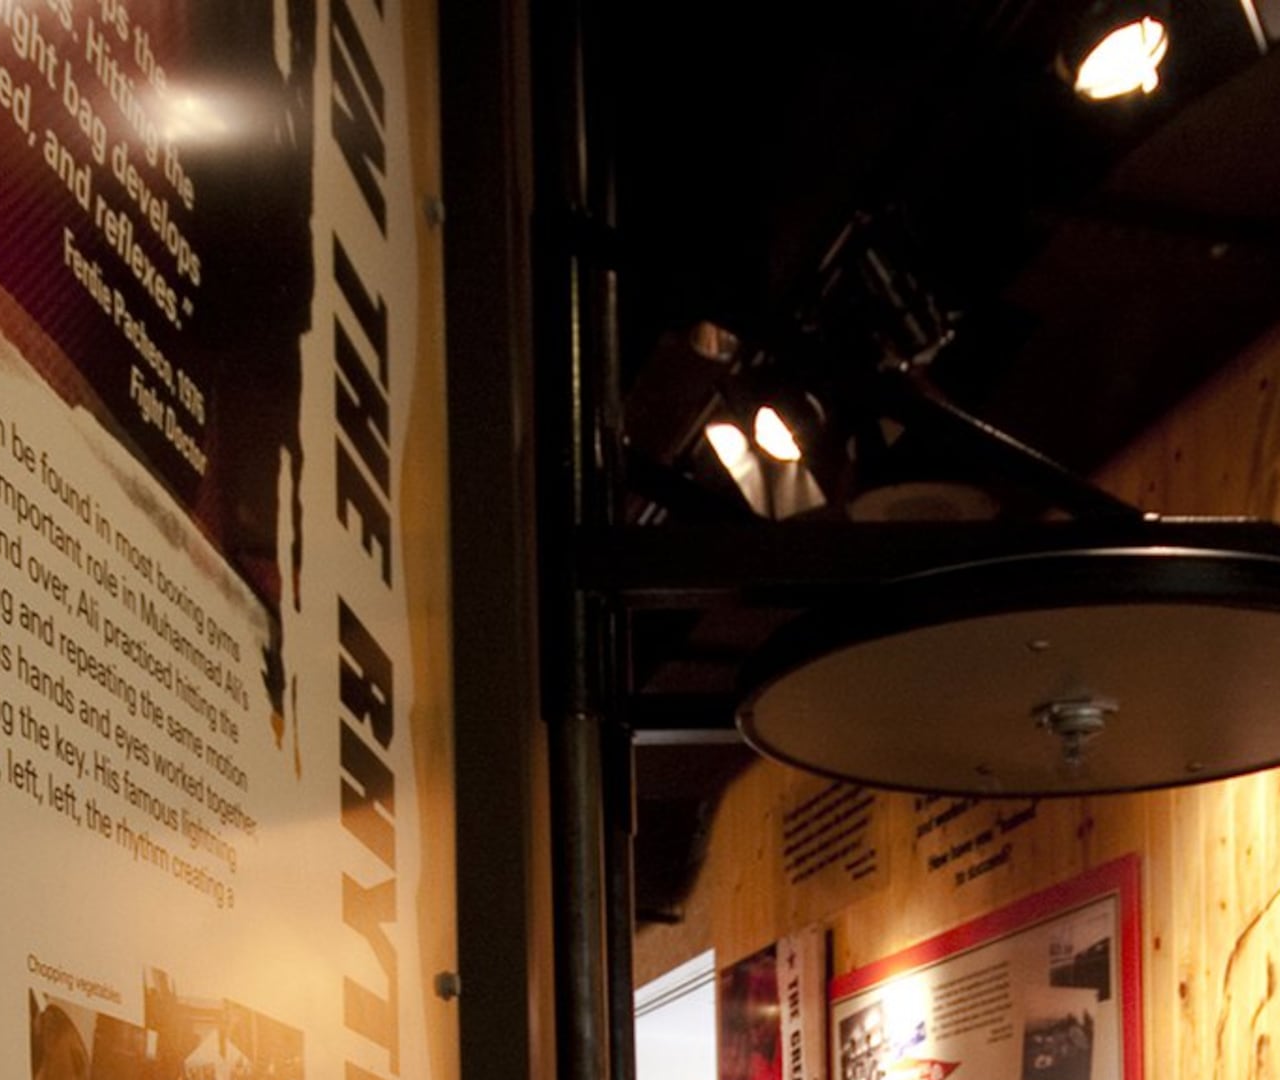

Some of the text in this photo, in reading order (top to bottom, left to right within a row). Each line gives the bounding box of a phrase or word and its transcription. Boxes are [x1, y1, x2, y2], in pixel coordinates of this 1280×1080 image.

[85, 16, 159, 167] Hitting
[43, 127, 93, 213] and
[63, 60, 108, 166] bag
[111, 141, 203, 288] develops
[128, 364, 209, 477] Fight Doctor
[331, 229, 393, 591] THE
[12, 423, 36, 473] be
[40, 452, 91, 525] found
[116, 531, 154, 584] most
[157, 564, 204, 636] boxing
[19, 602, 54, 648] and
[60, 634, 137, 717] repeating
[140, 691, 164, 729] the
[28, 556, 72, 613] over,
[77, 589, 99, 631] Ali
[104, 619, 172, 691] practiced
[87, 554, 118, 598] role
[140, 592, 222, 688] Muhammad
[18, 646, 75, 715] hands
[79, 699, 111, 739] and
[115, 724, 150, 767] eyes
[153, 751, 204, 803] worked
[19, 707, 50, 751] the
[55, 726, 89, 778] key.
[94, 751, 120, 794] His
[123, 776, 178, 831] famous
[8, 749, 43, 804] left,
[49, 774, 81, 825] left,
[85, 800, 112, 838] the
[26, 952, 124, 1005] Chopping vegetables
[784, 976, 802, 1023] THE
